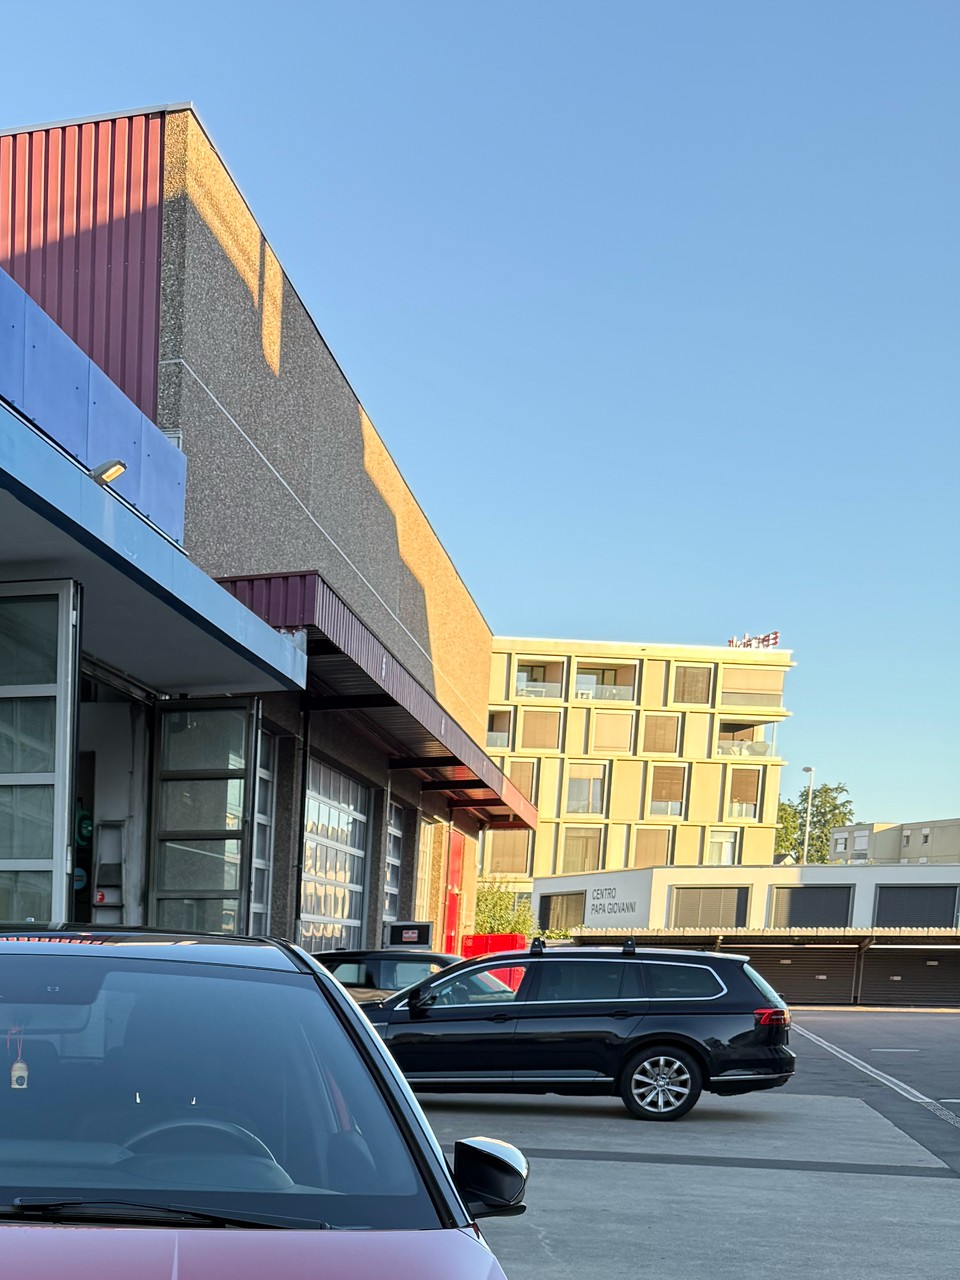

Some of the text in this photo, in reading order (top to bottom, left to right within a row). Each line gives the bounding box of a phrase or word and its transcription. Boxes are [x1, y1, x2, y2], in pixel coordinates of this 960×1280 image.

[592, 887, 617, 900] CENTRO
[591, 901, 637, 915] PAPA GIOVANNI
